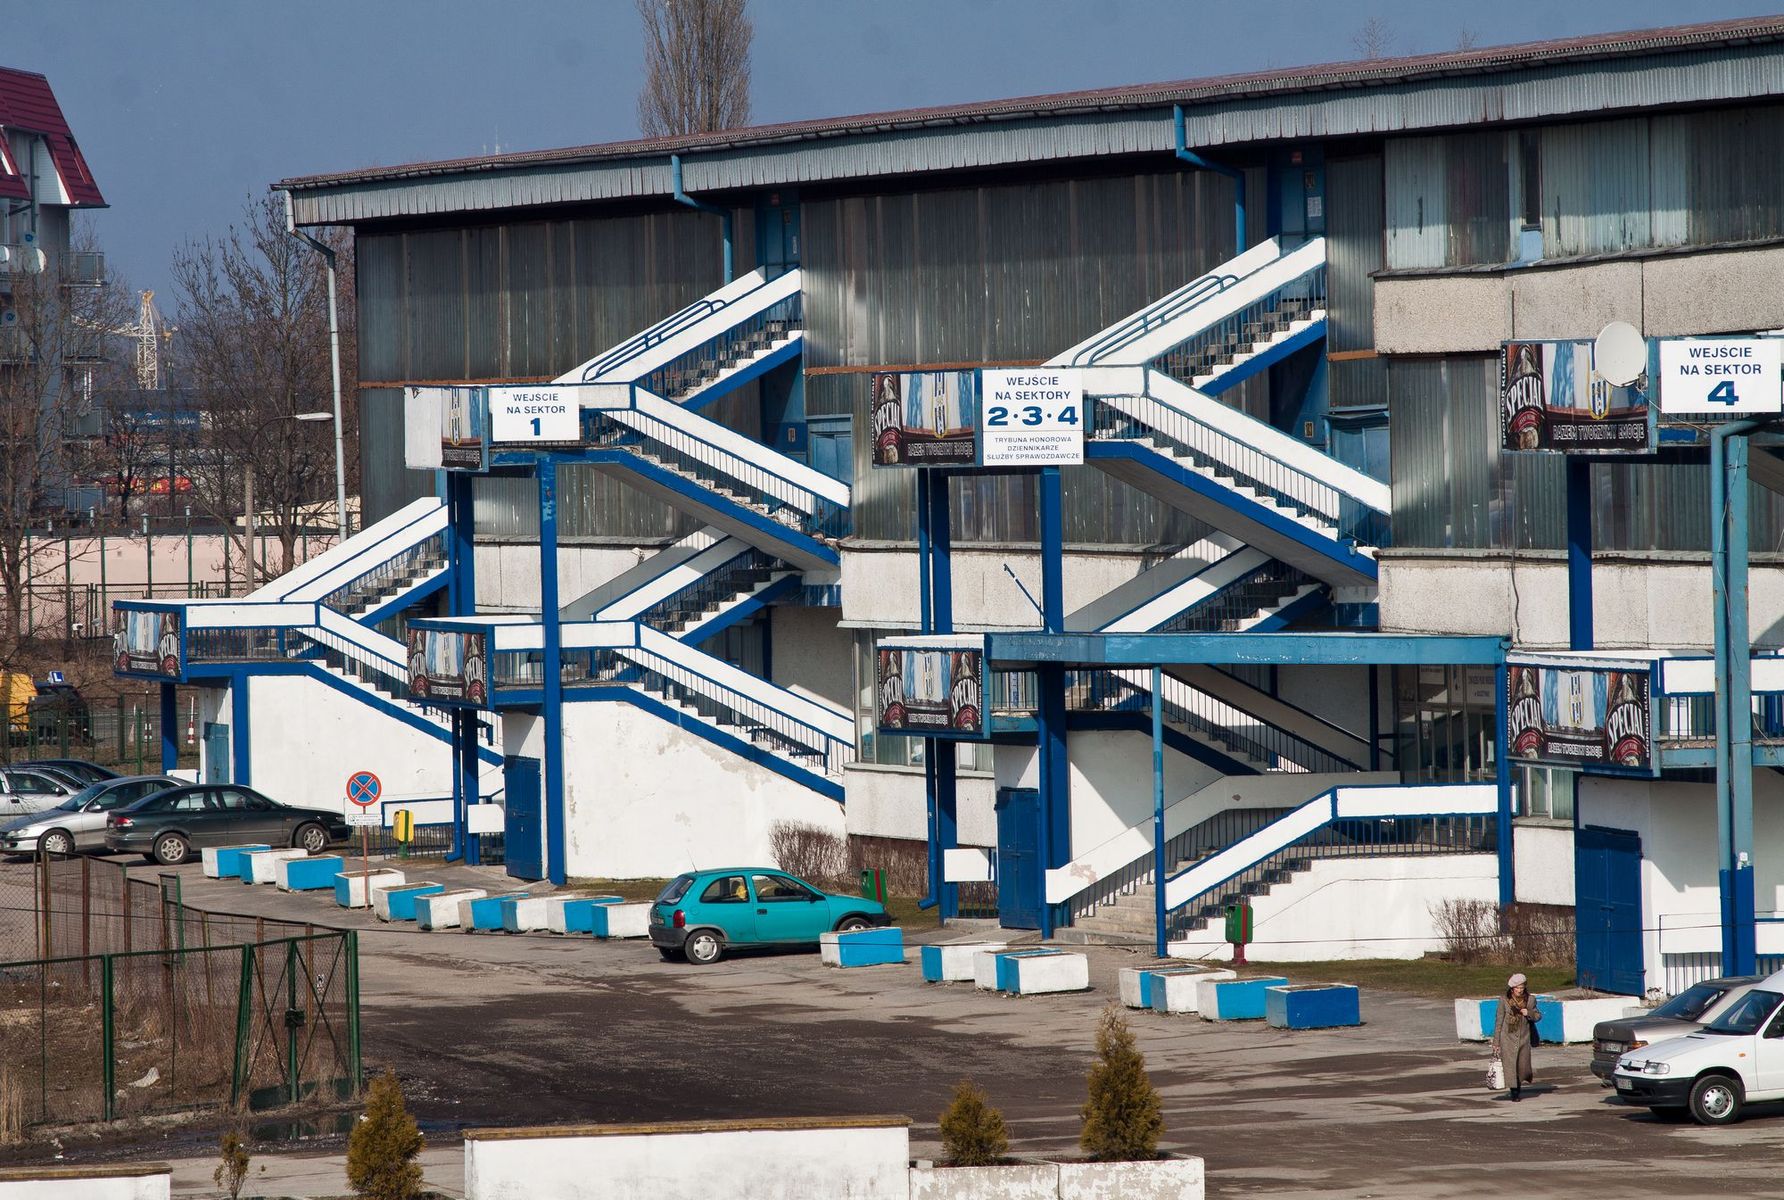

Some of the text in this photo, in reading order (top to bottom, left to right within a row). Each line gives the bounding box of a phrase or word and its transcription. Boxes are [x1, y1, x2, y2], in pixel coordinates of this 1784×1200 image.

[1689, 345, 1752, 358] WEJŚCIE
[1680, 364, 1762, 375] NA SEKTOR
[1006, 374, 1059, 386] WEJŚCIE
[995, 391, 1071, 400] NA SEKTORY
[1506, 375, 1544, 422] SPECJAL
[1707, 381, 1739, 406] 4
[506, 405, 566, 414] NA SEKTOR
[530, 417, 541, 436] 1
[1015, 452, 1081, 460] SPRAWOZDAWCZE
[53, 672, 62, 682] L
[1511, 698, 1543, 741] SPECJAL
[1608, 703, 1645, 749] SPECJAL
